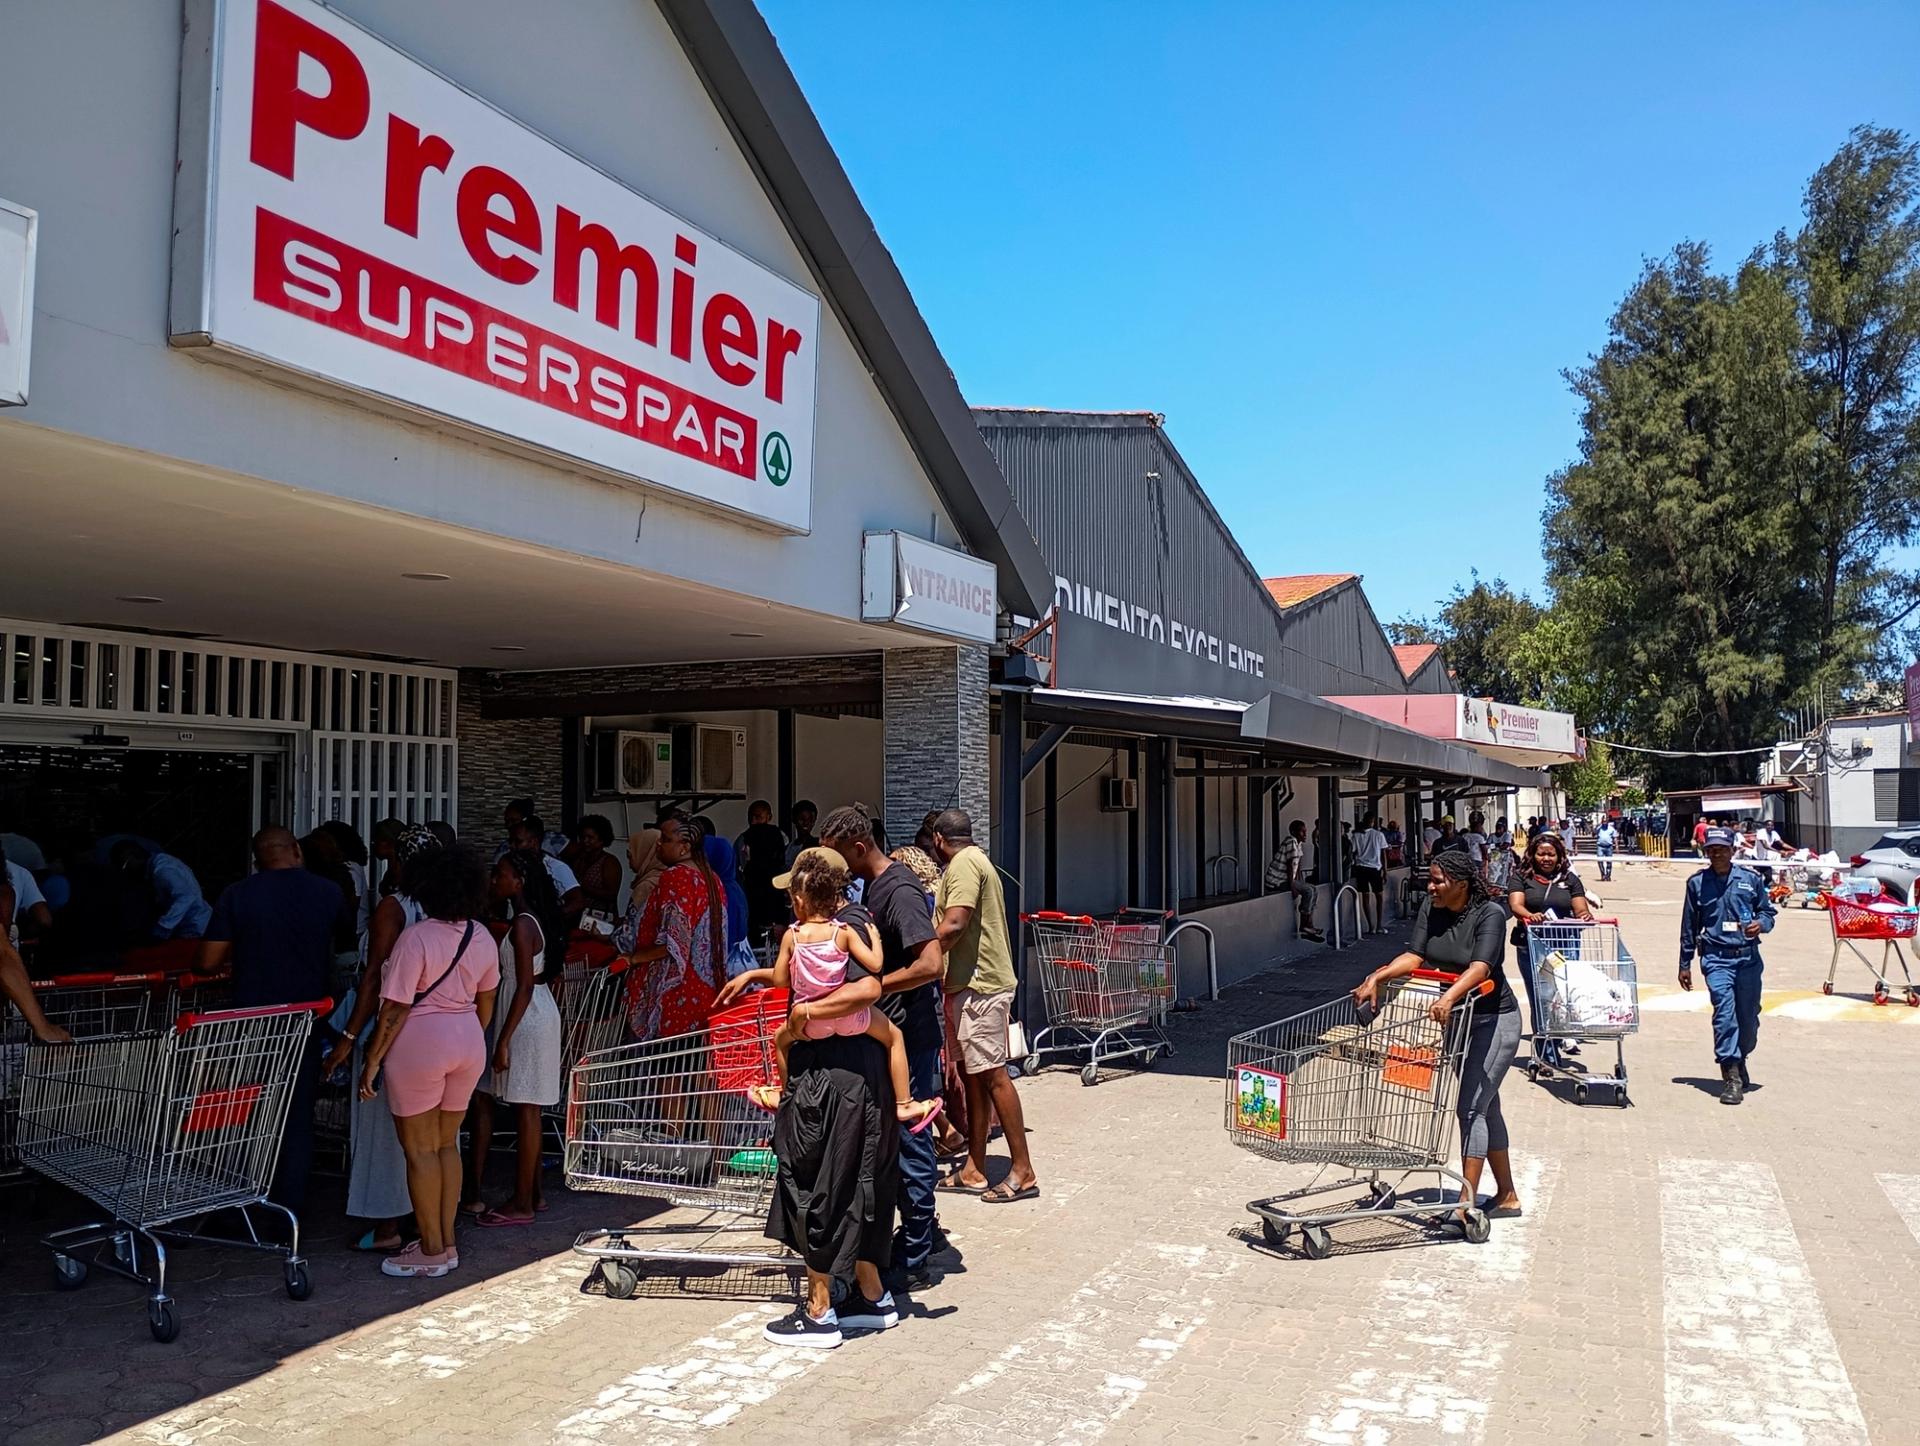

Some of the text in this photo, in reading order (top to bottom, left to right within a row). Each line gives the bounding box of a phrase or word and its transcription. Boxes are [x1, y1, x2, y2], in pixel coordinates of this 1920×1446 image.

[249, 0, 802, 404] Premier
[281, 240, 745, 466] SUPERSPAR
[903, 563, 993, 617] NTRANCE
[1501, 708, 1540, 730] Premier
